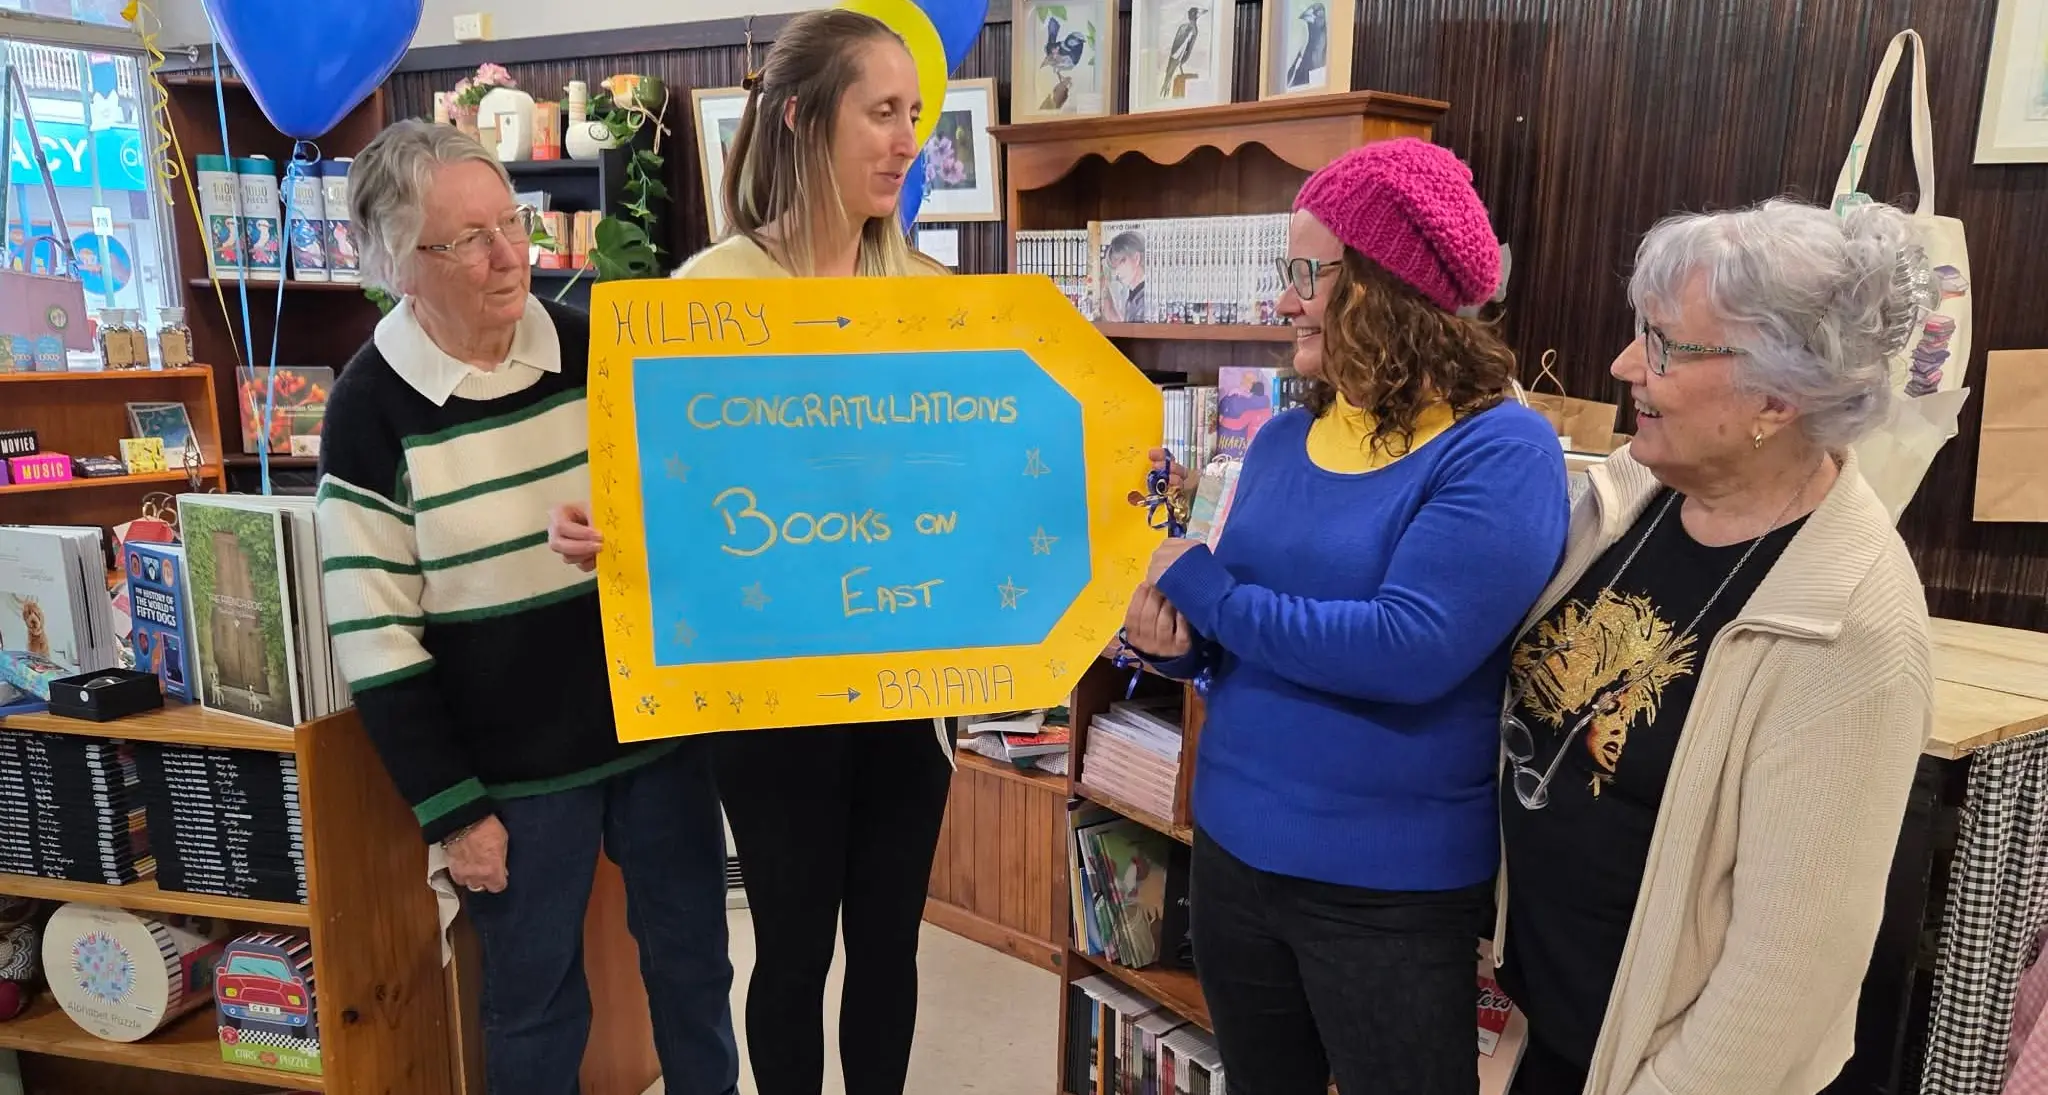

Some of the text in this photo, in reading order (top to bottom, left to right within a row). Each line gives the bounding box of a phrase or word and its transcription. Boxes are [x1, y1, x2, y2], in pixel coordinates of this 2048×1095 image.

[612, 300, 770, 346] HILARY
[686, 391, 1018, 430] CONGRATULATIONS
[0, 436, 35, 454] MOVIES
[22, 462, 64, 480] MUSIC
[136, 596, 147, 606] THE
[147, 598, 169, 613] WORLD
[143, 588, 166, 602] HISTORY
[166, 595, 174, 605] OF
[137, 606, 177, 627] FIFTY DOGS
[877, 665, 1013, 709] BRIANA
[280, 1055, 310, 1068] PUZZLE
